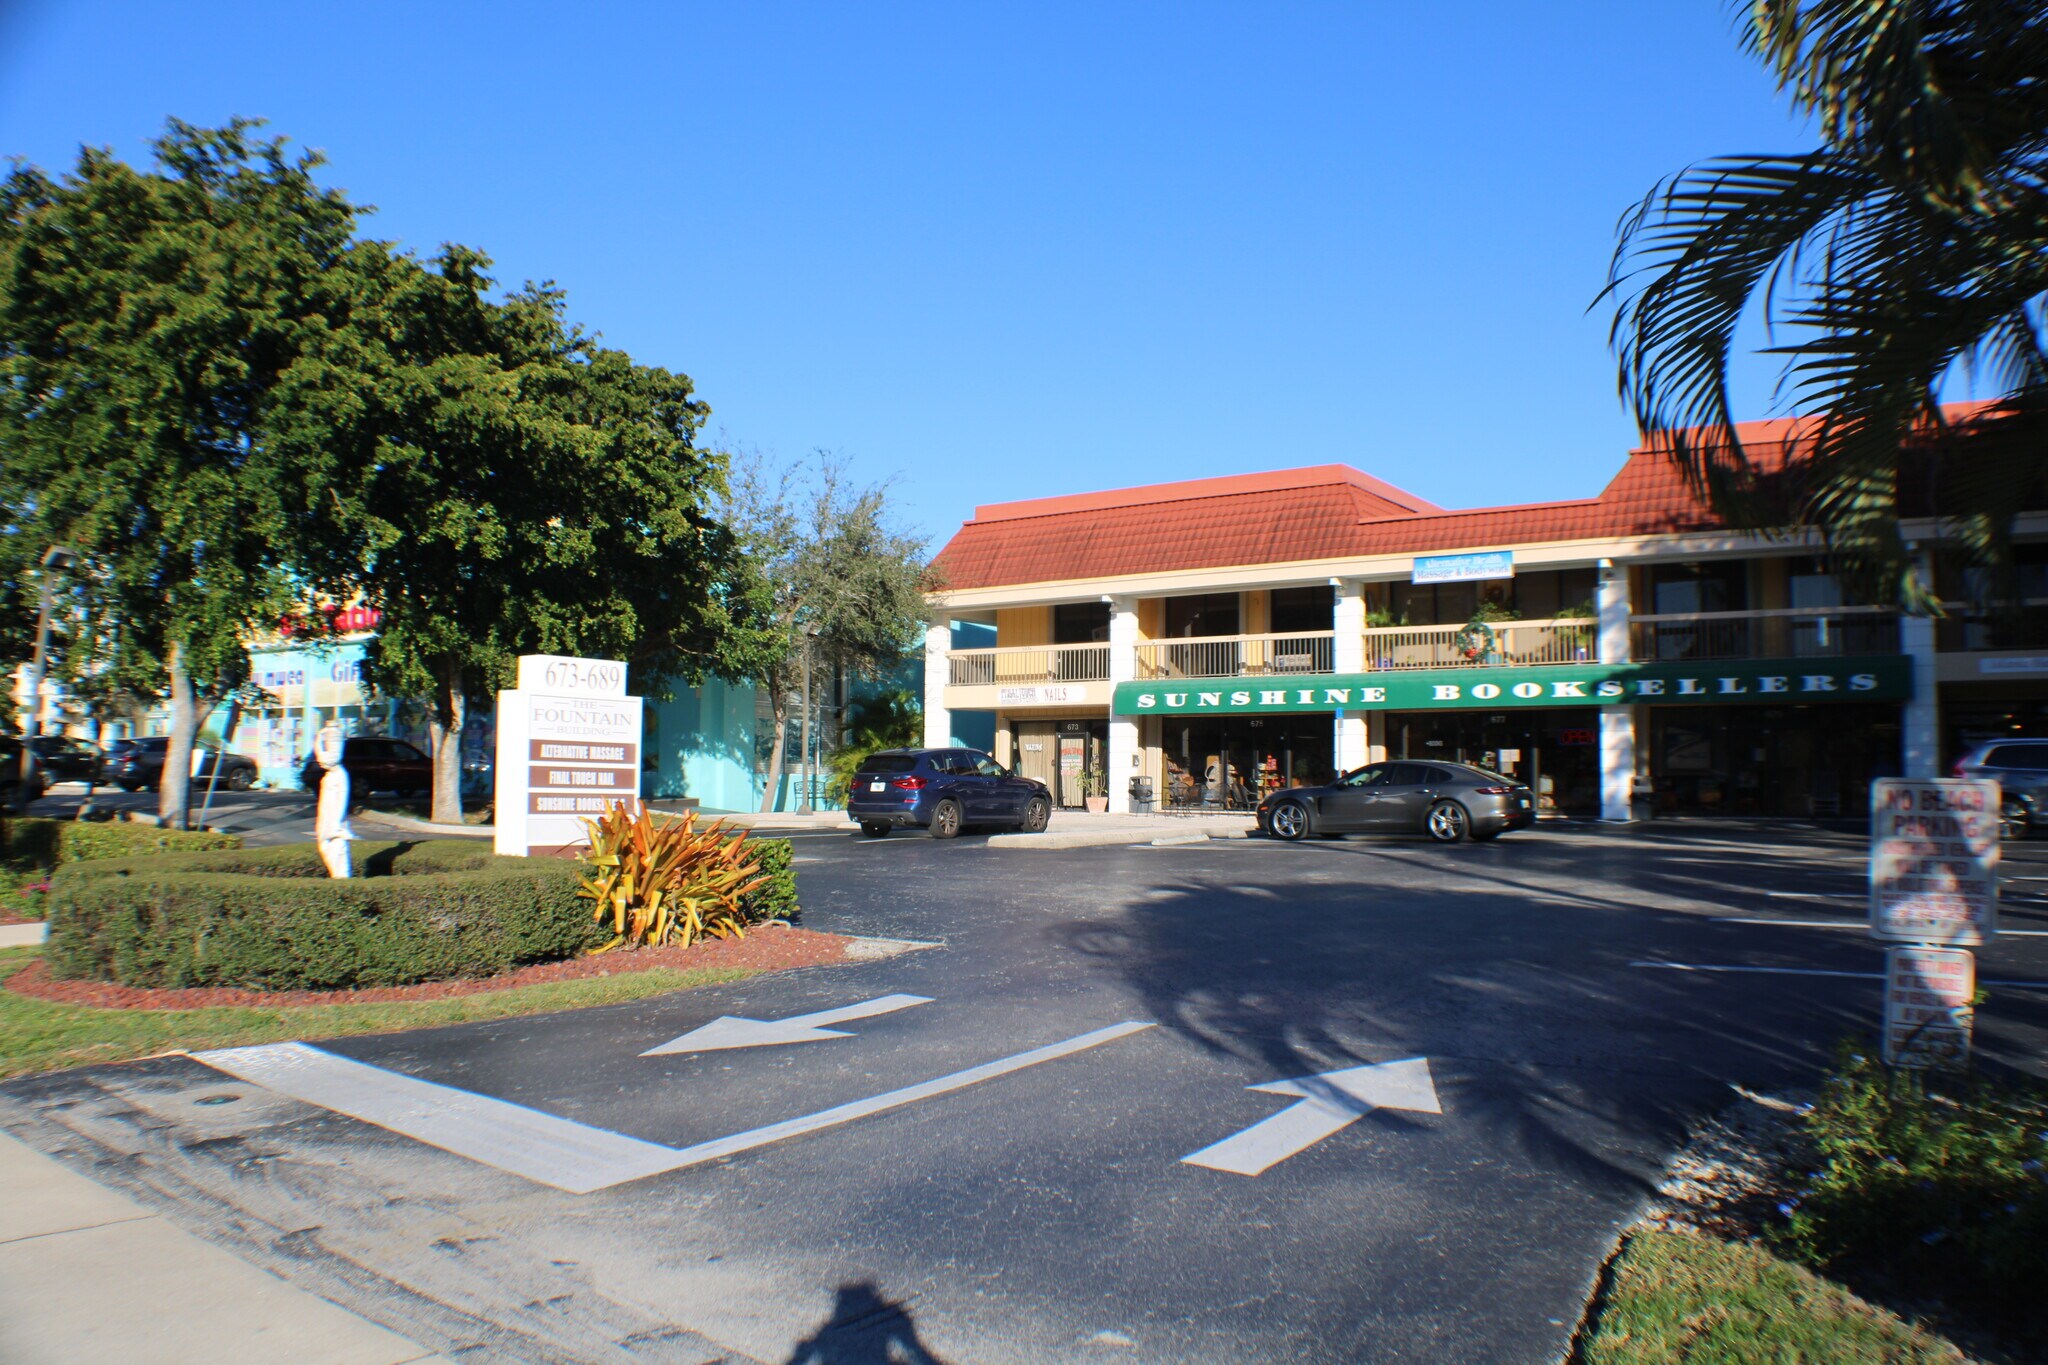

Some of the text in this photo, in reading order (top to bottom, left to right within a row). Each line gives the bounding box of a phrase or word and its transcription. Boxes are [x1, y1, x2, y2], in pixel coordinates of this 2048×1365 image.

[546, 661, 619, 690] 673-689
[1044, 687, 1067, 702] NAILS
[1137, 674, 1877, 708] SUNSHINE BOOKSELLERS
[573, 700, 597, 709] THE
[533, 709, 632, 725] FOUNTAIN
[557, 726, 610, 736] BUILDING
[1067, 723, 1079, 731] 673
[541, 743, 625, 761] ALTERNATIVE MASSAGE
[549, 770, 616, 786] FINAL TOUCH NAIL
[537, 796, 576, 811] SUNSHINE
[1886, 789, 1985, 812] NO BEACH
[1893, 815, 1978, 837] PARKING
